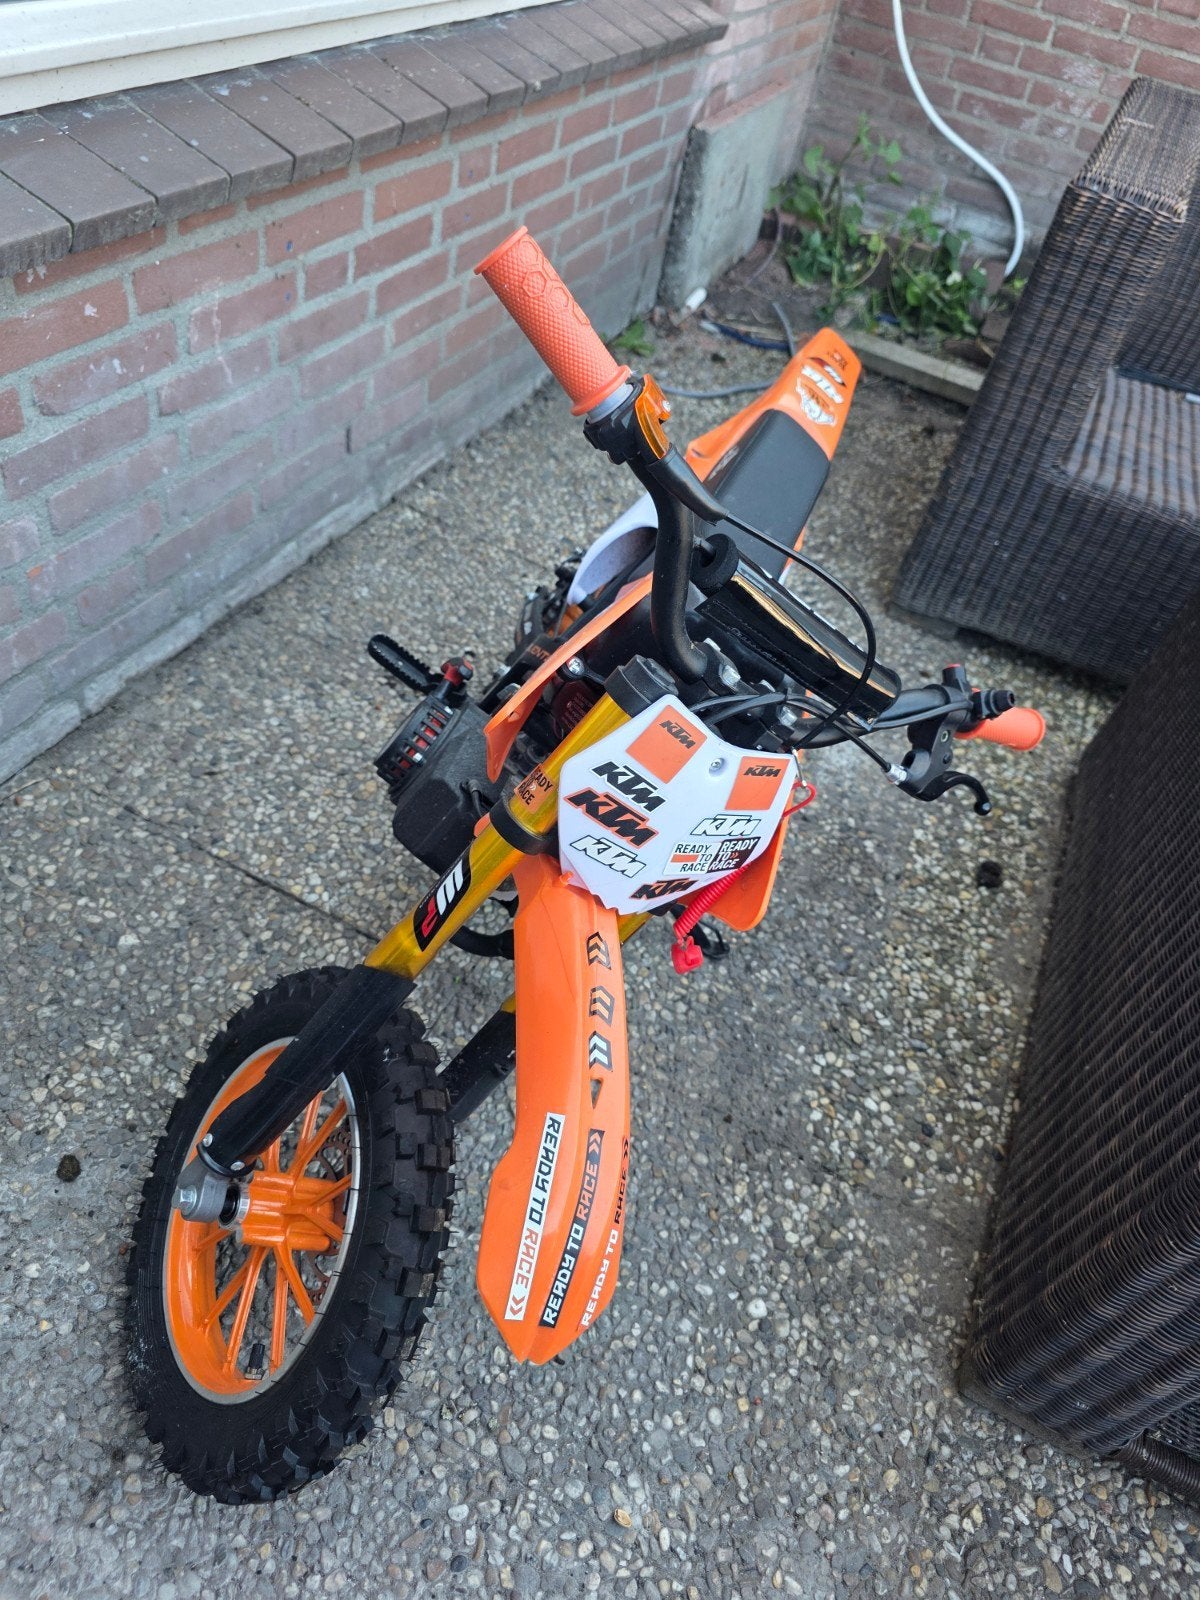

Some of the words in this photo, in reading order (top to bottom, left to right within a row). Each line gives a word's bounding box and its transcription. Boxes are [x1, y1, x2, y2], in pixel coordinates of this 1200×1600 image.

[659, 719, 697, 750] KTM
[743, 764, 782, 778] KTM
[592, 760, 667, 813] KTM
[564, 787, 659, 849] KTM
[690, 814, 762, 837] KTM
[570, 835, 647, 878] KTM
[675, 843, 712, 854] READY
[699, 853, 713, 862] TO
[716, 851, 731, 862] TO
[721, 838, 758, 853] READY
[680, 862, 708, 873] RACE
[709, 858, 739, 871] RACE
[630, 878, 699, 900] KTM
[536, 1116, 562, 1193] READY
[528, 1195, 550, 1227] TO
[542, 1255, 576, 1326] READY
[567, 1226, 585, 1254] TO
[577, 1162, 600, 1222] RACE
[580, 1260, 610, 1327] READY
[605, 1229, 620, 1255] TO
[613, 1168, 628, 1225] RACE
[515, 1227, 539, 1290] RACE
